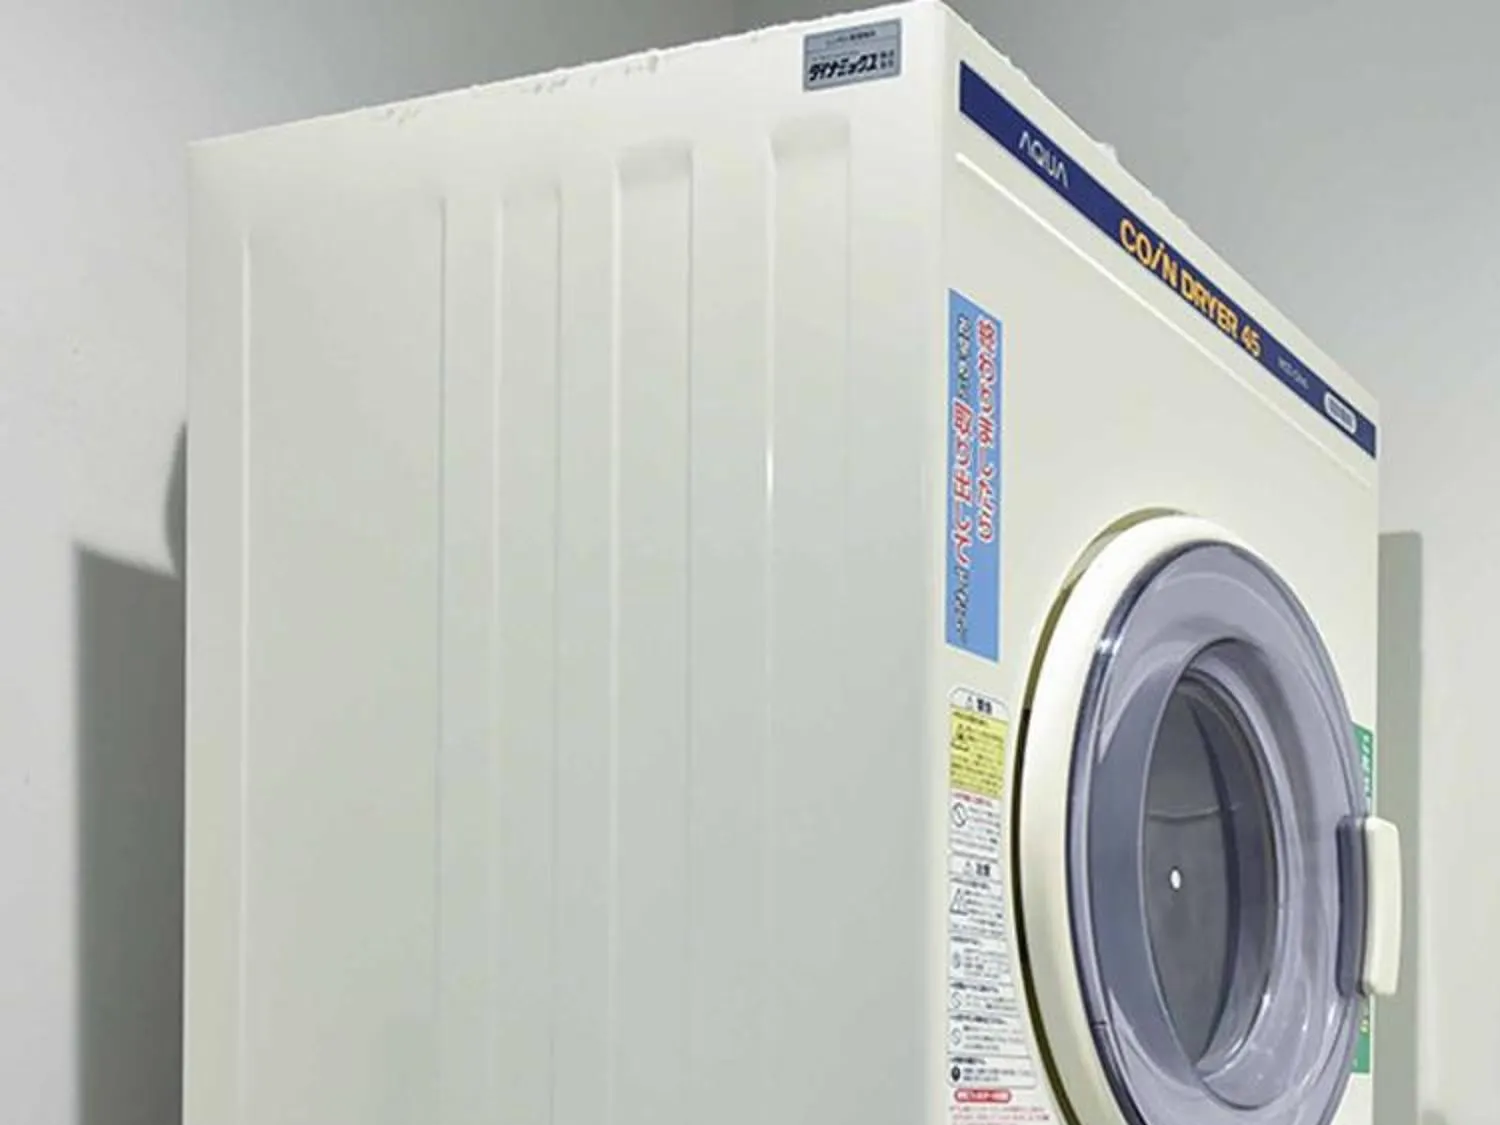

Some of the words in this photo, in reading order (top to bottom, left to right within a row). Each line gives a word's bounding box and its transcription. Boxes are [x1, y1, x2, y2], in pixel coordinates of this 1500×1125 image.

[1018, 131, 1069, 189] AQUA
[1180, 268, 1239, 339] DRYER
[1241, 324, 1261, 358] 45
